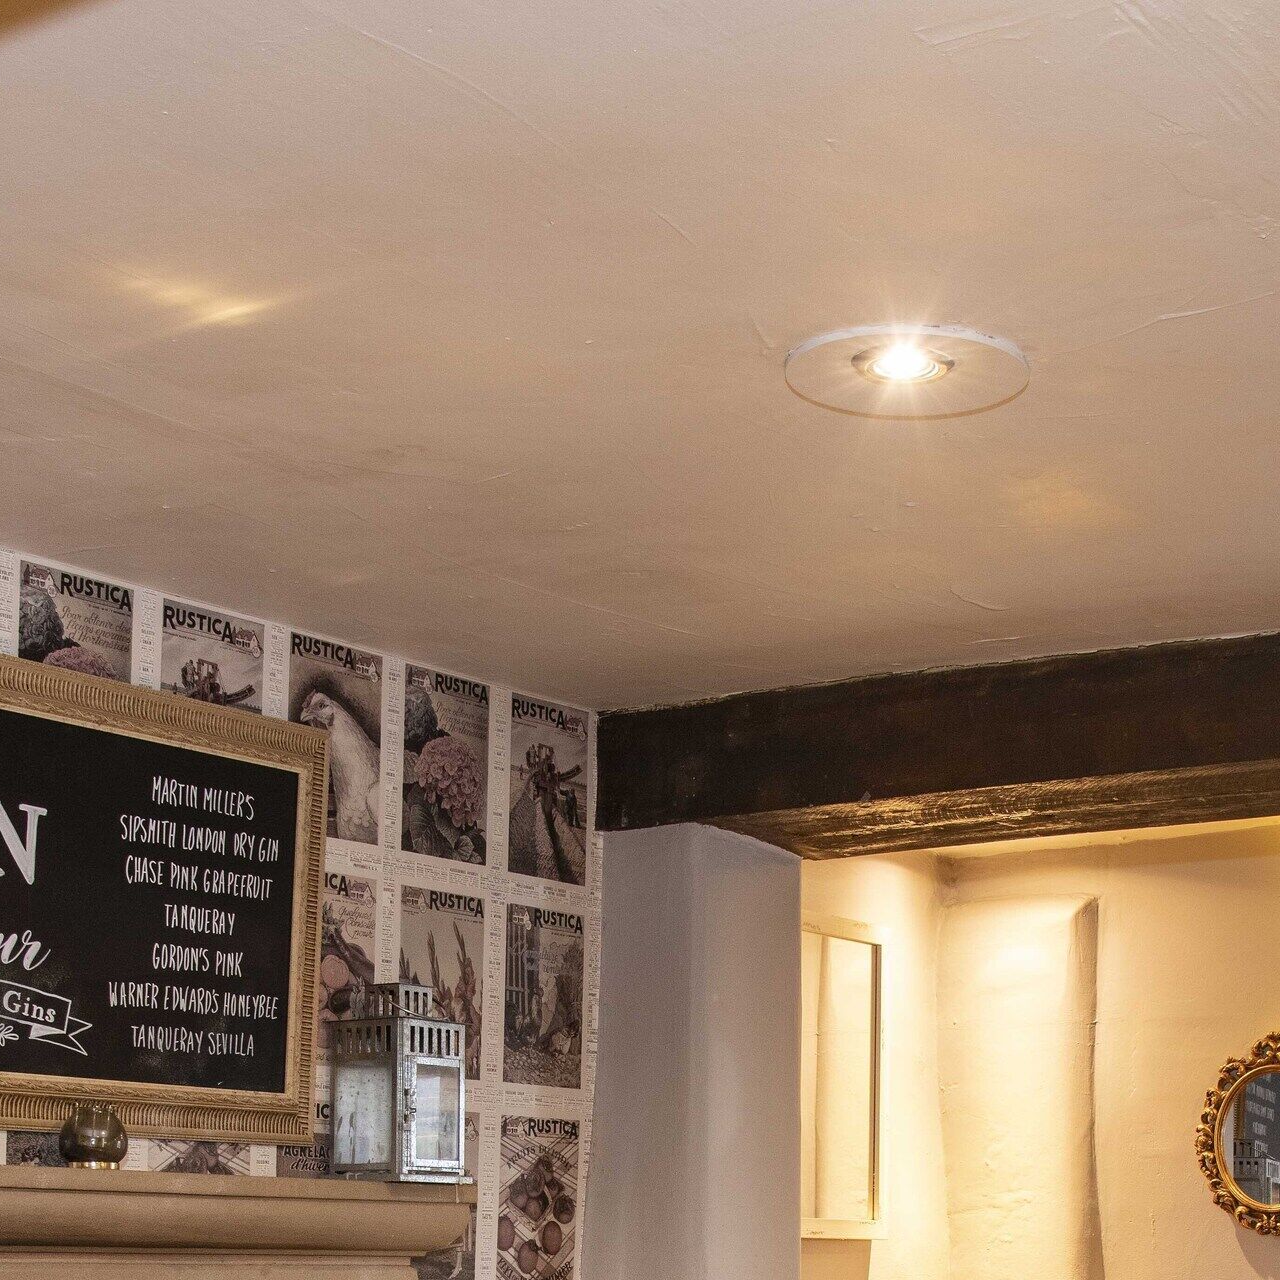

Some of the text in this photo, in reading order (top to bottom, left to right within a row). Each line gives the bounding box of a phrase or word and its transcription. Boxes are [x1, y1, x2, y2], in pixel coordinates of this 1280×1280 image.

[60, 573, 131, 612] RUSTICA
[163, 605, 235, 645] RUSTICA
[292, 634, 355, 670] RUSTICA
[435, 673, 488, 705] RUSTICA
[512, 698, 566, 730] RUSTICA
[152, 776, 254, 820] MARTIN MILLER'S
[120, 814, 279, 862] SIPSMITH LONDON DRY GIN
[126, 855, 273, 900] CHASE PINK GRAPEFRUIT
[165, 904, 235, 936] TANQUERAY
[429, 890, 484, 918] RUSTICA
[534, 909, 583, 935] RUSTICA
[152, 943, 243, 977] GORDON'S PINK
[2, 990, 56, 1022] Gins
[109, 982, 278, 1020] WARNER EDWARD'S HONEYBEE
[131, 1024, 254, 1056] TANQUERAY SEVILLA
[528, 1119, 578, 1139] RUSTICA
[284, 1146, 330, 1158] AGNELA
